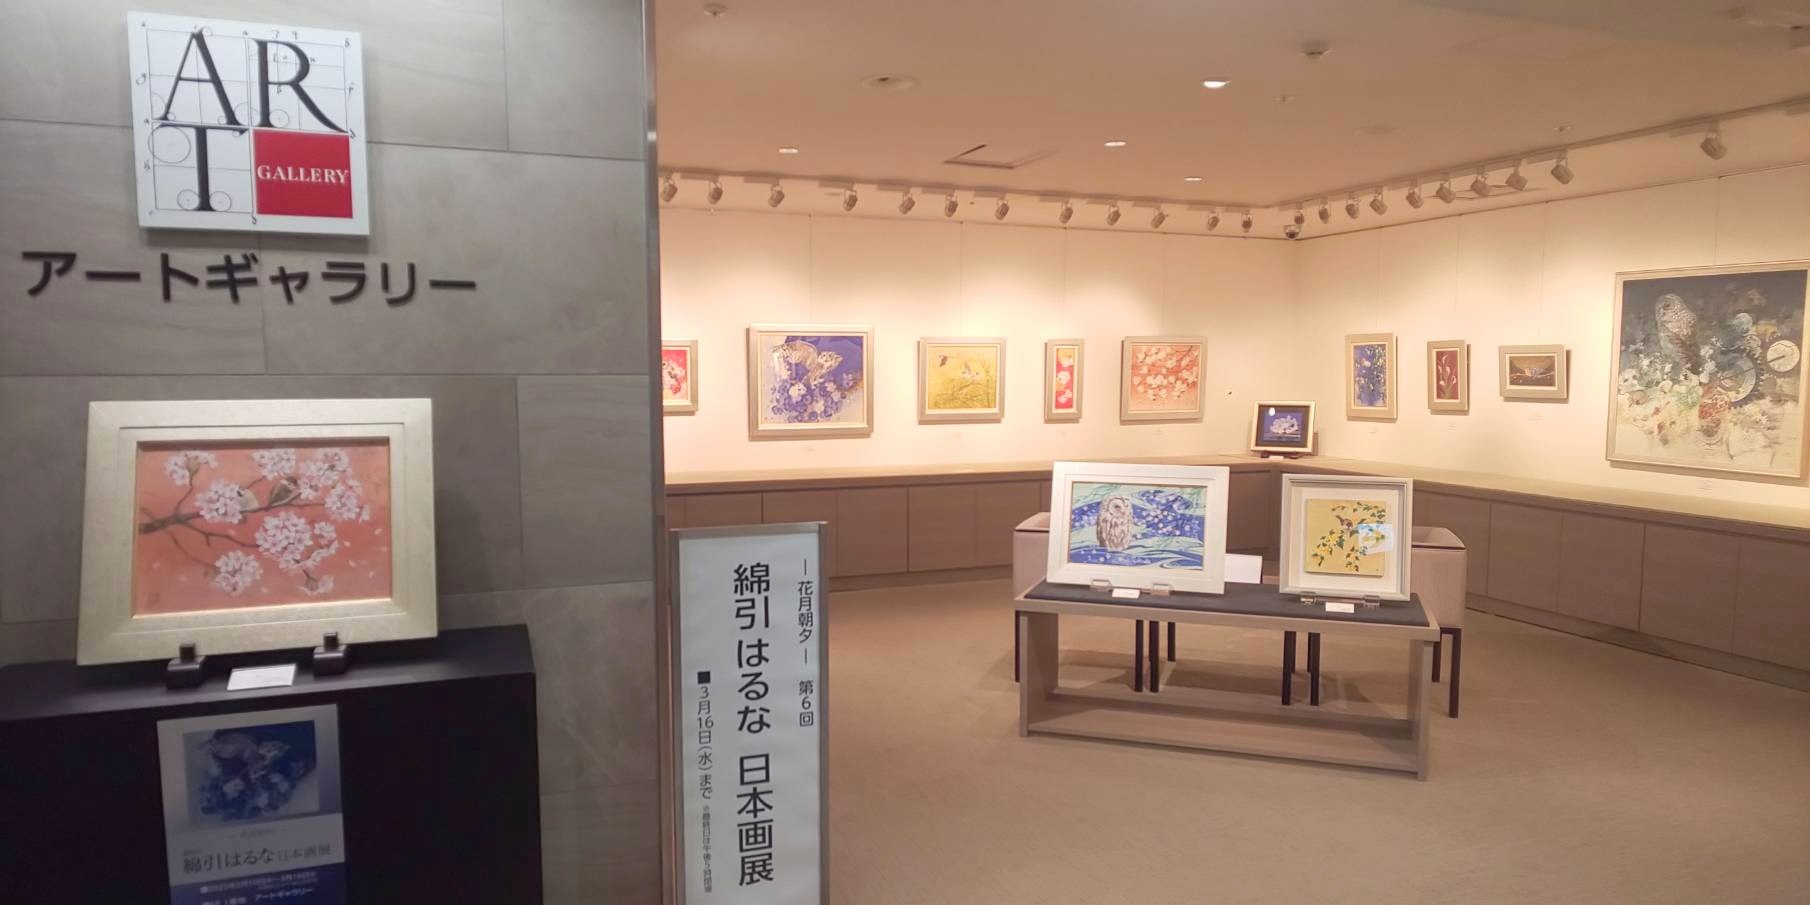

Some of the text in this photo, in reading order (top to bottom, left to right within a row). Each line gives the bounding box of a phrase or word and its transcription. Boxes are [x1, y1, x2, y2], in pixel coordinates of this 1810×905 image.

[256, 164, 349, 184] GALLERY
[22, 251, 476, 305] アートギャラリー
[799, 680, 814, 727] 第6回
[736, 753, 774, 886] 日本画展
